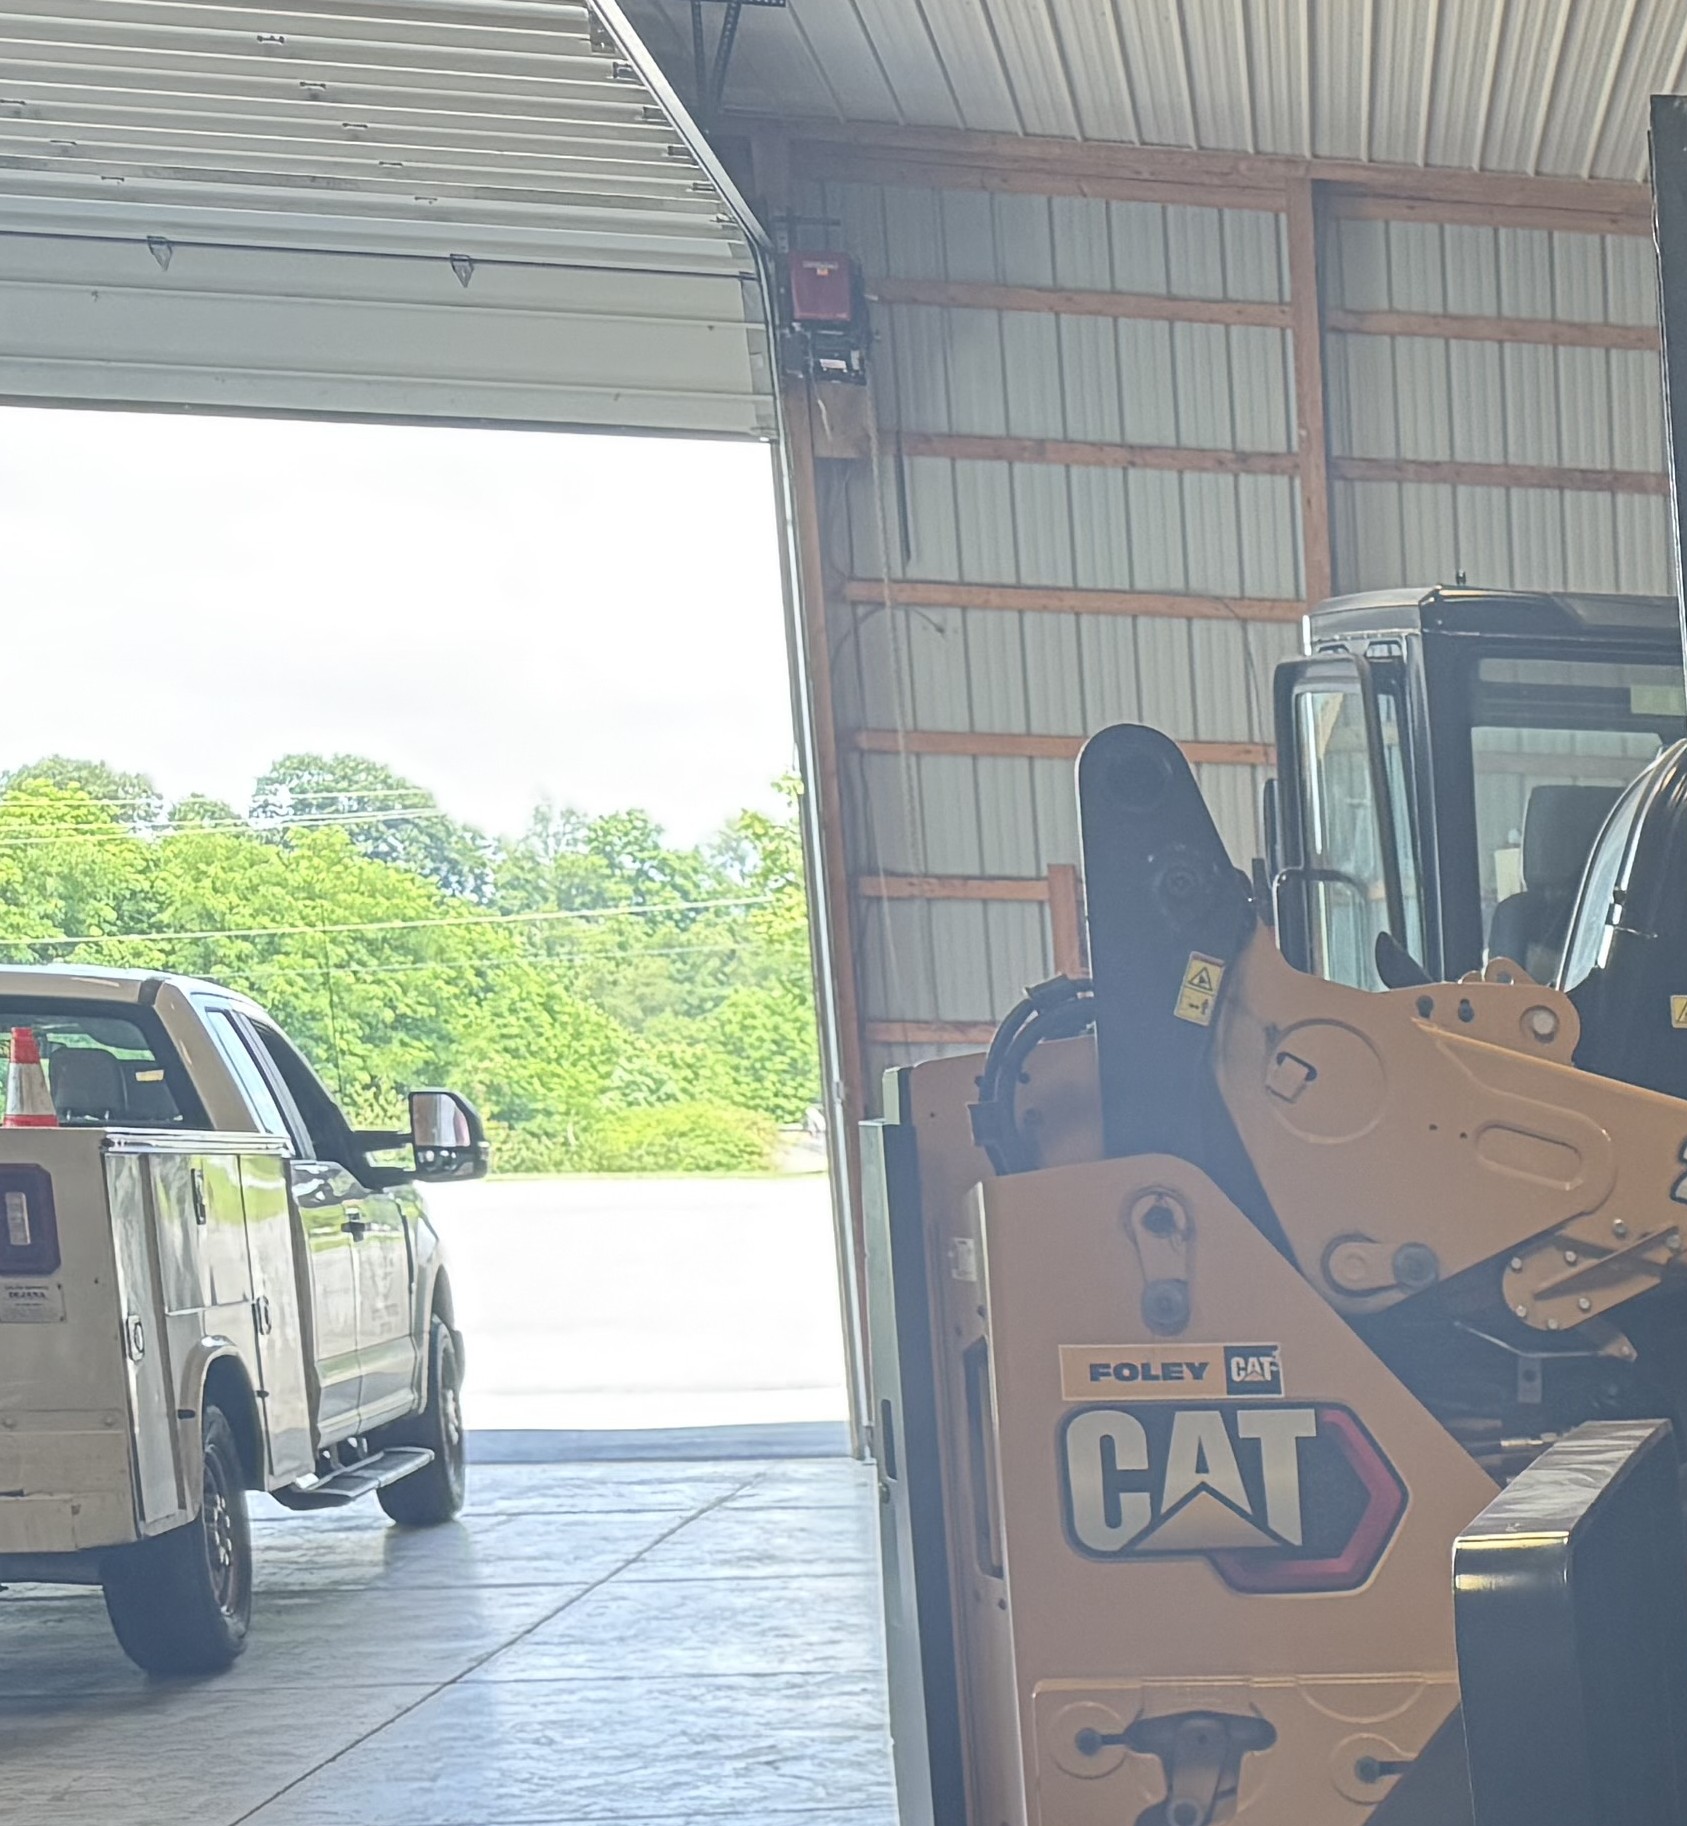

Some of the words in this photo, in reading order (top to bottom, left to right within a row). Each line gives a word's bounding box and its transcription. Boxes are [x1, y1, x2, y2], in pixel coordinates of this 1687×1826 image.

[1089, 1361, 1210, 1382] FOLEY
[1231, 1355, 1278, 1382] CAT
[1066, 1408, 1317, 1552] CAT
